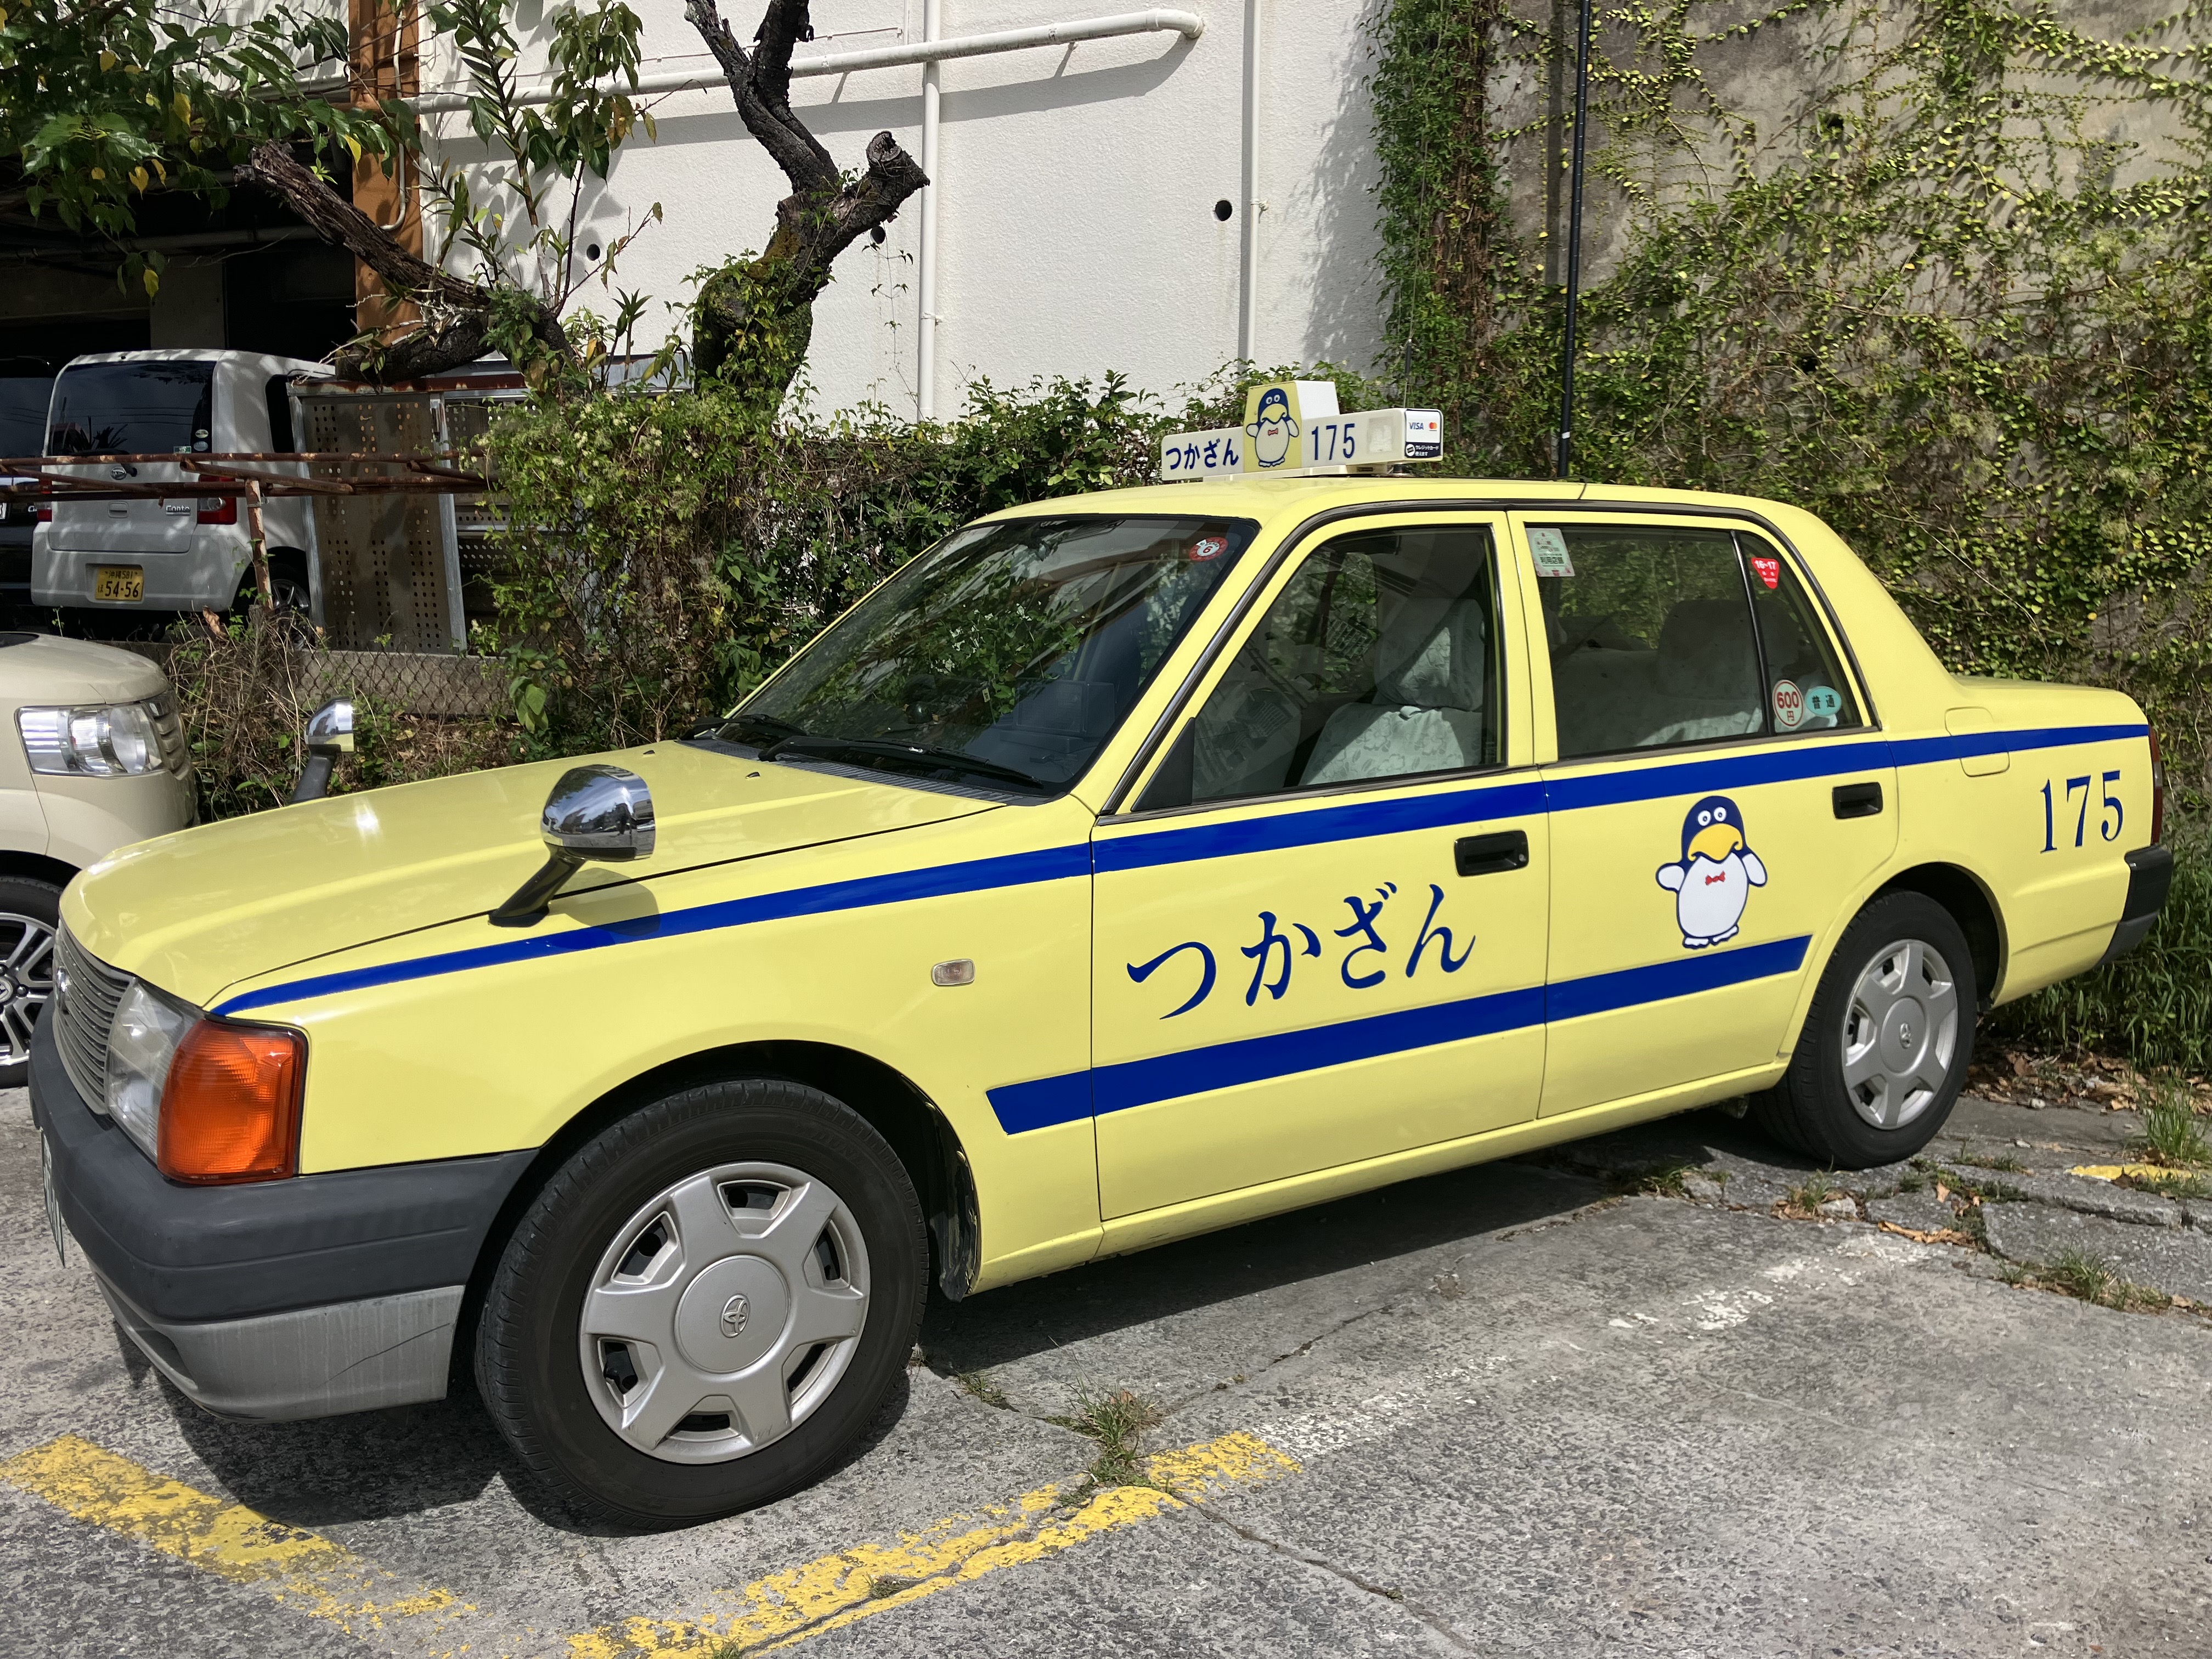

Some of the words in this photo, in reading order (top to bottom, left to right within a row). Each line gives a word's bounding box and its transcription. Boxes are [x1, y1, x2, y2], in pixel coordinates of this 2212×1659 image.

[1408, 422, 1424, 430] VISA
[1165, 438, 1239, 470] つかざん
[1311, 423, 1355, 460] 175
[105, 580, 140, 598] 54-56
[1777, 691, 1799, 709] 600
[1787, 710, 1795, 721] 円
[2040, 770, 2123, 854] 175
[1126, 882, 1476, 1020] つかざん
